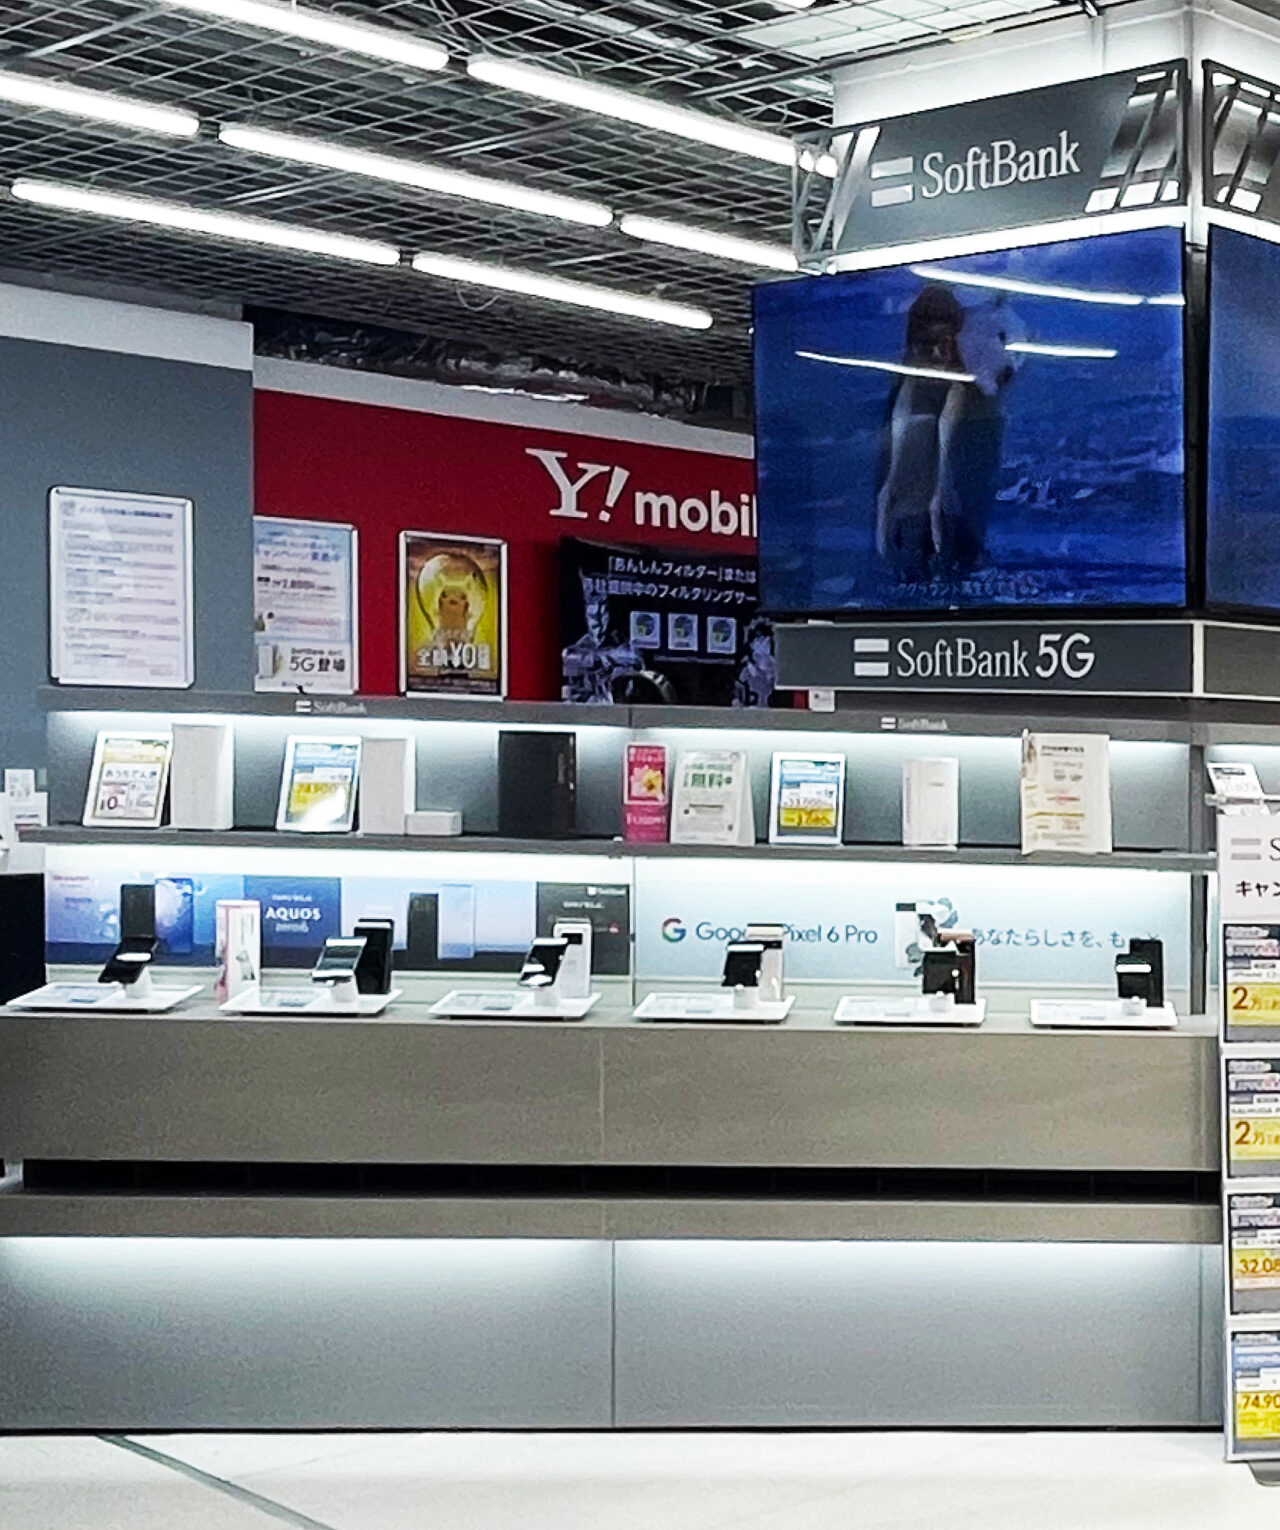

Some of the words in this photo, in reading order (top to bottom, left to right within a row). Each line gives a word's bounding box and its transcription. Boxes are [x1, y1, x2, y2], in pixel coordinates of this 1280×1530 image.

[922, 130, 1082, 199] SoftBank
[896, 635, 1030, 678] SoftBank
[1035, 633, 1095, 680] 5G
[313, 701, 367, 714] SoftBank
[265, 906, 321, 921] AQUOS
[783, 923, 822, 943] Pixel
[827, 925, 840, 944] 6
[846, 924, 878, 944] Pro
[972, 929, 1160, 949] あなたらしさを、も
